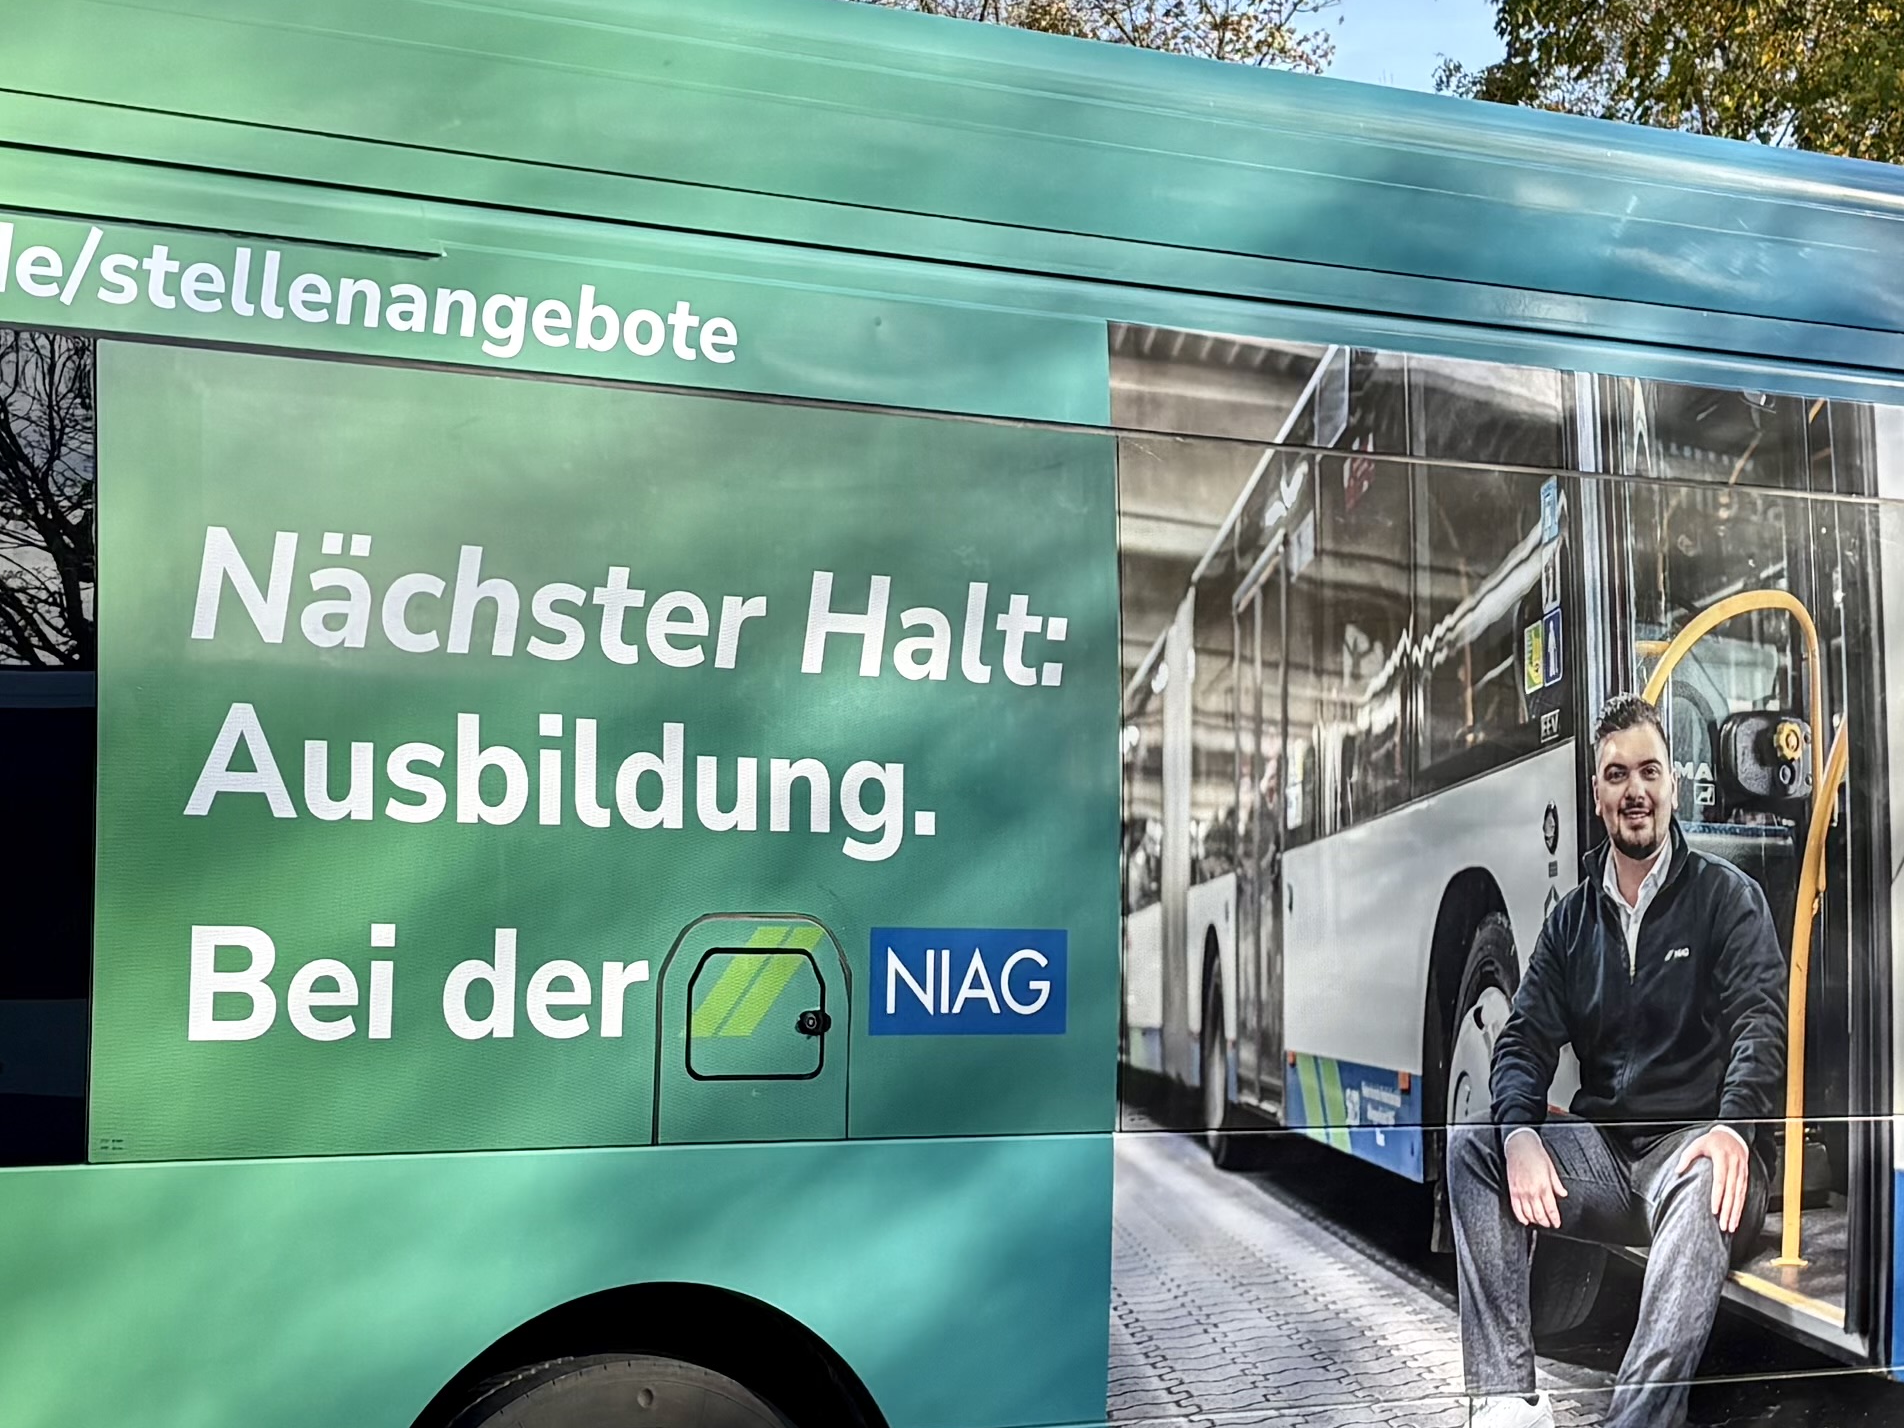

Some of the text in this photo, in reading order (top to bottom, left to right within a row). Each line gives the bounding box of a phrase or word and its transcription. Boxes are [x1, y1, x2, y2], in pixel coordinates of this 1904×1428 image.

[190, 526, 1068, 686] Nächster Halt:
[184, 701, 937, 862] Ausbildung.
[188, 923, 1052, 1041] Bei der NIAG
